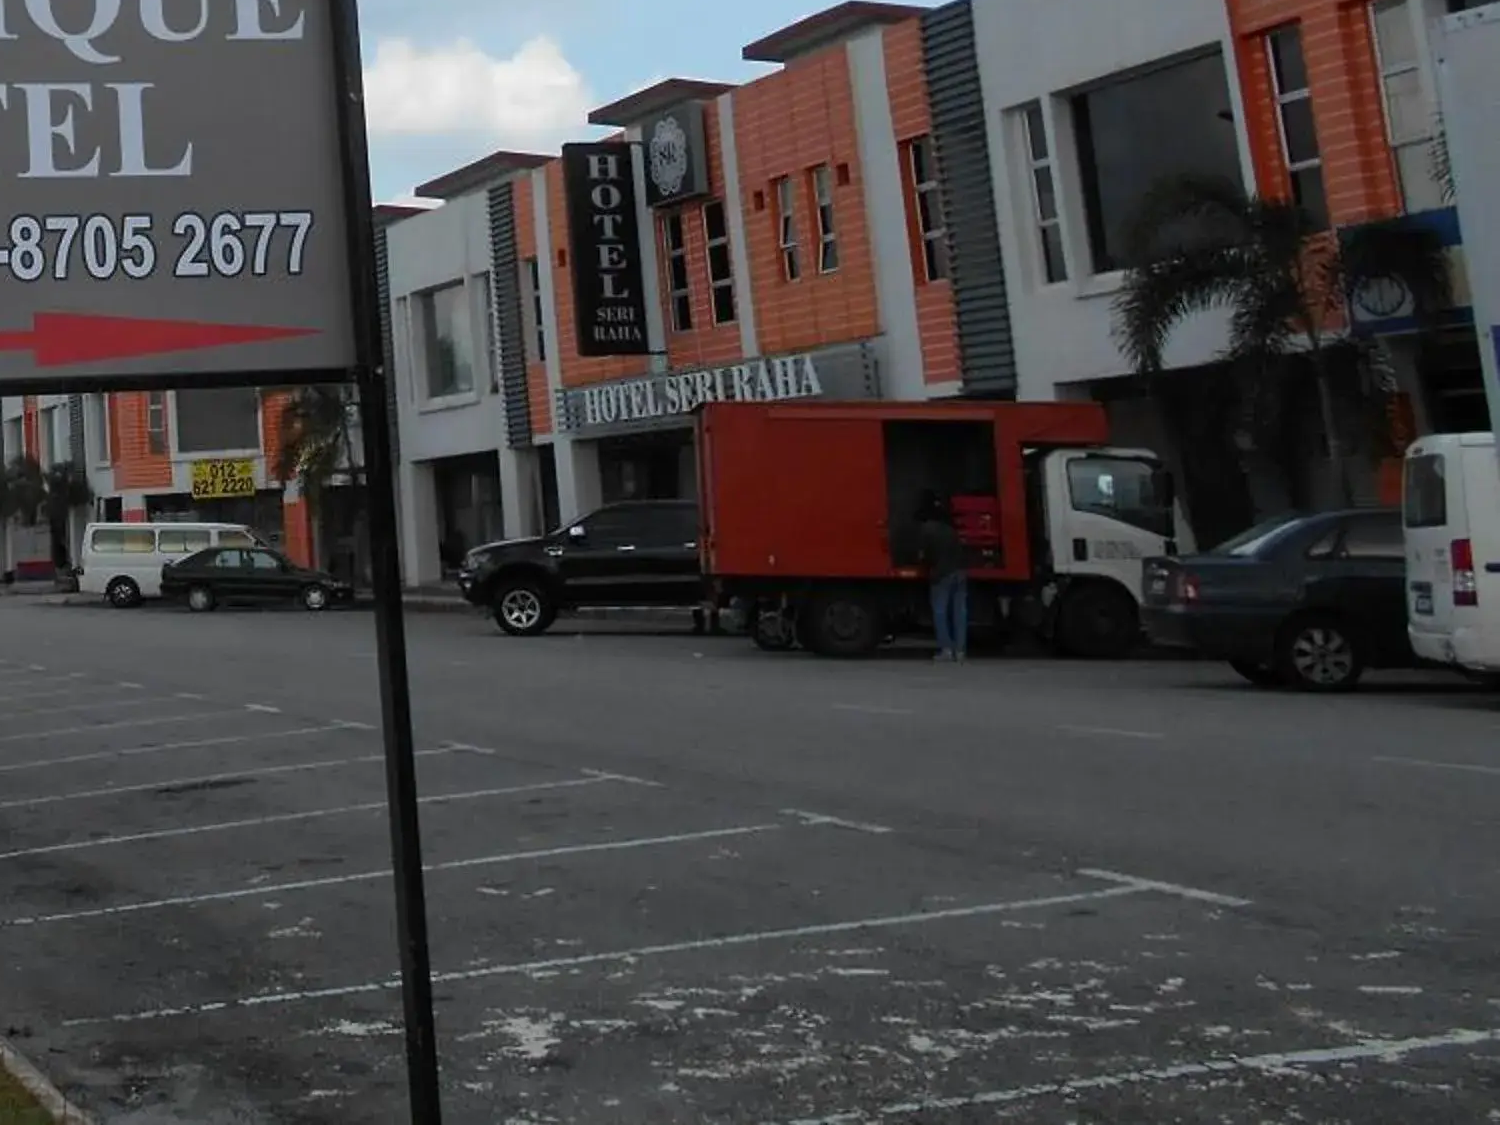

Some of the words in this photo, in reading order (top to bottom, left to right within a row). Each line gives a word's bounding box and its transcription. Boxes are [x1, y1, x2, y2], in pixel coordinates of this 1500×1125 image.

[172, 211, 313, 277] 2677
[586, 154, 629, 299] HOTEL
[596, 305, 636, 323] SERI
[584, 380, 665, 424] HOTEL
[665, 368, 727, 413] SERI
[730, 355, 823, 402] RAHA
[209, 462, 236, 478] 012
